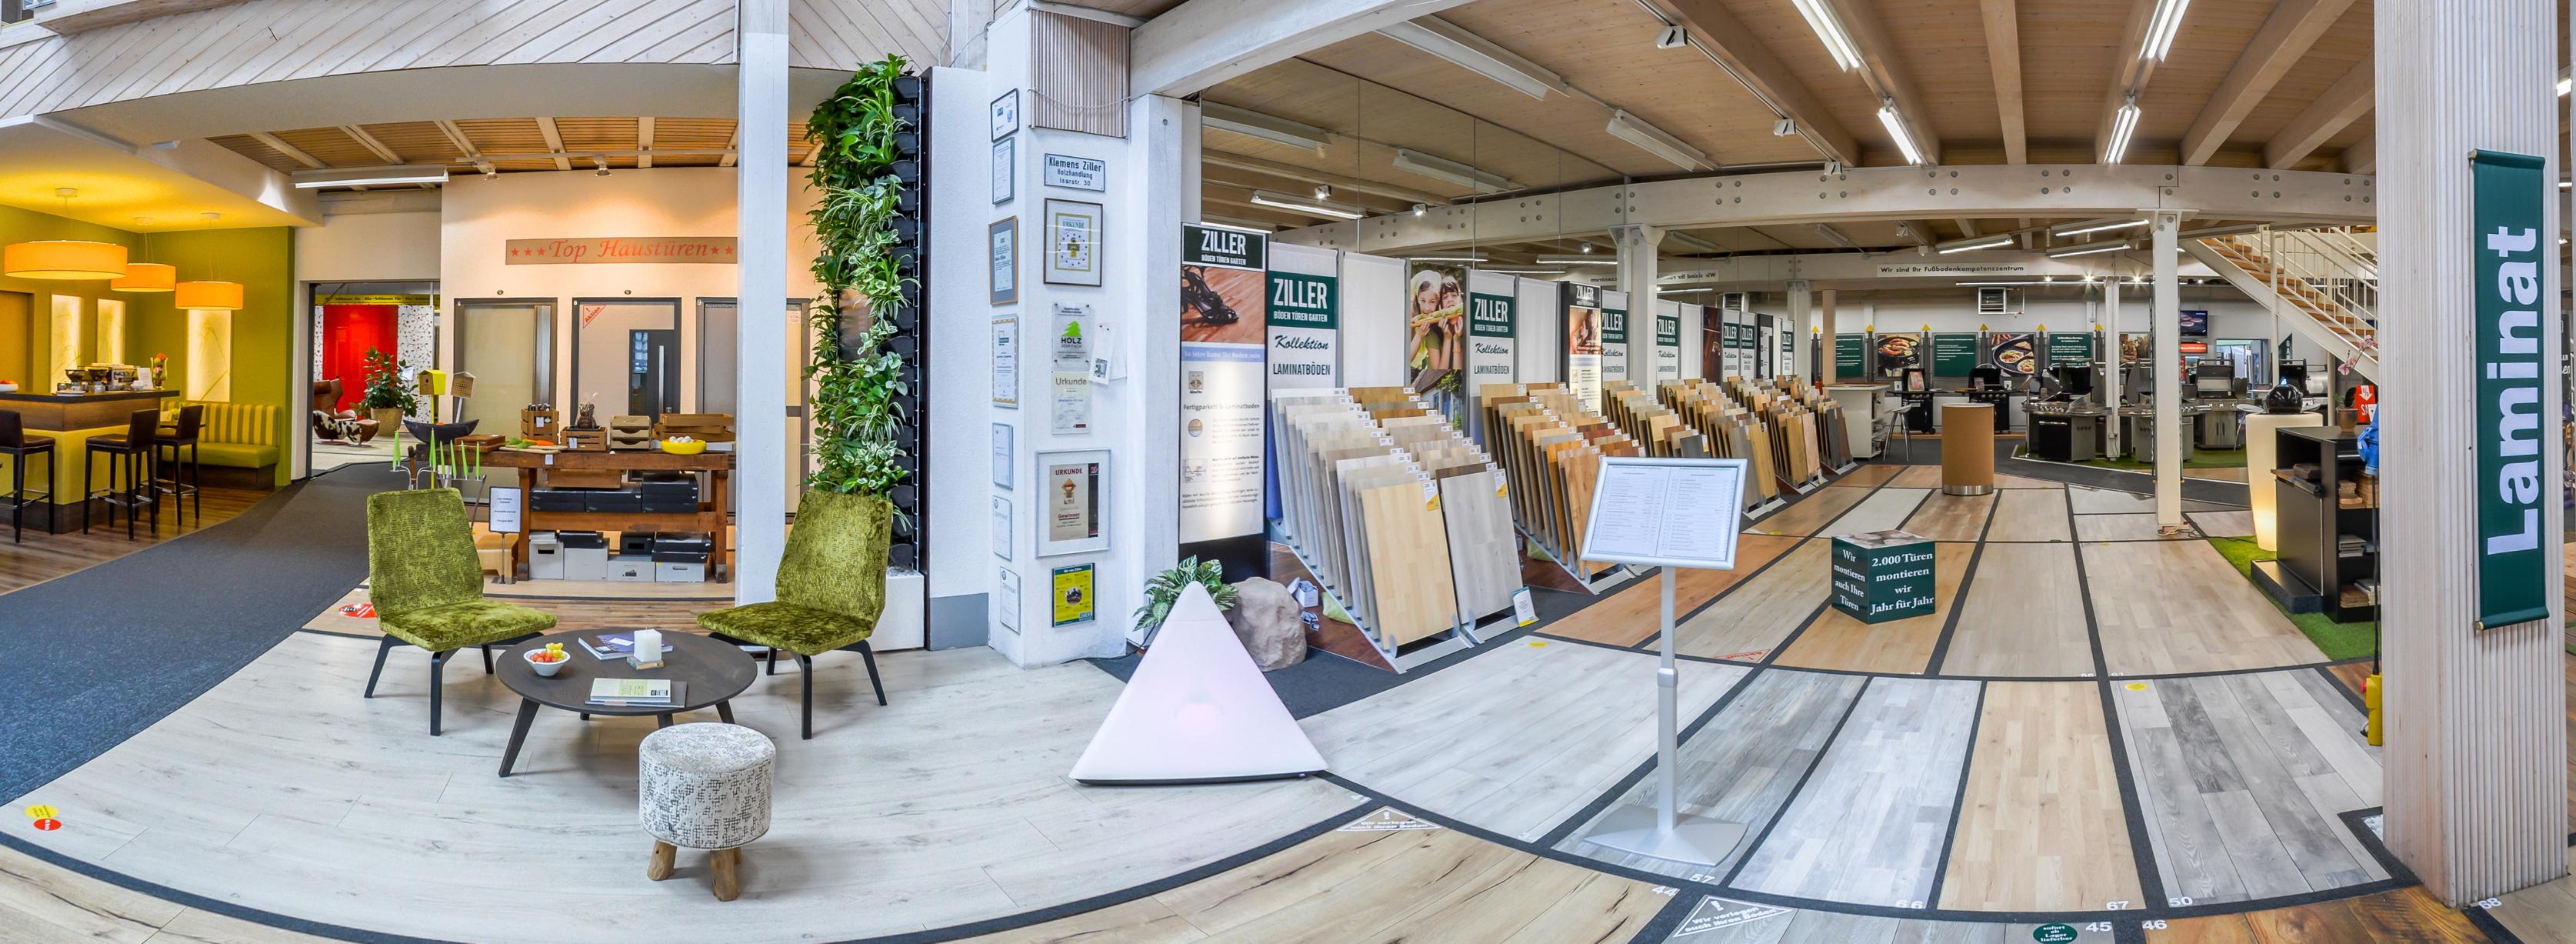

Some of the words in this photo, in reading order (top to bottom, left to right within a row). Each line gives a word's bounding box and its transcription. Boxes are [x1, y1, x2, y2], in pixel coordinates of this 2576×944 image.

[1049, 157, 1079, 169] Klemens
[1083, 161, 1101, 172] Ziller
[1057, 168, 1093, 180] Holzhandlung
[1201, 230, 1246, 255] ZILLER
[548, 239, 587, 262] Top
[598, 239, 708, 258] Haustüren
[1274, 278, 1328, 309] ZILLER
[584, 305, 601, 323] Aktion
[1274, 310, 1291, 319] BÖDEN
[1291, 311, 1308, 321] TÜREN
[1308, 313, 1328, 322] GARTEN
[1475, 298, 1508, 322] ZILLER
[1658, 319, 1675, 335] ZILLER
[1275, 335, 1329, 349] Kollektion
[1475, 343, 1508, 355] Kollektion
[1273, 362, 1331, 375] LAMINATBÖDEN
[1475, 363, 1509, 374] LAMINATBÖDEN
[1055, 377, 1087, 385] Urkunde
[2487, 225, 2539, 555] Laminat
[1843, 549, 1856, 562] Wir
[1871, 555, 1901, 567] 2.000
[1901, 552, 1933, 563] Türen
[1834, 564, 1865, 582] montieren
[1876, 569, 1929, 582] montieren
[1835, 580, 1850, 591] auch
[1850, 583, 1865, 598] Ihre
[1895, 585, 1912, 594] wir
[1839, 594, 1859, 612] Türen
[1870, 602, 1895, 615] Jahr
[1895, 599, 1911, 609] für
[1911, 595, 1934, 609] Jahr
[1689, 874, 1715, 883] 57
[1652, 886, 1680, 896] 44
[1895, 899, 1924, 909] 66
[2105, 901, 2129, 910] 67
[2169, 897, 2193, 906] 50
[1685, 922, 1711, 932] auch
[1714, 916, 1741, 926] Ihren
[1742, 908, 1777, 920] Boden
[1693, 916, 1711, 925] Wir
[1715, 906, 1760, 921] verlegen
[2085, 922, 2112, 932] 45
[2142, 920, 2168, 930] 46
